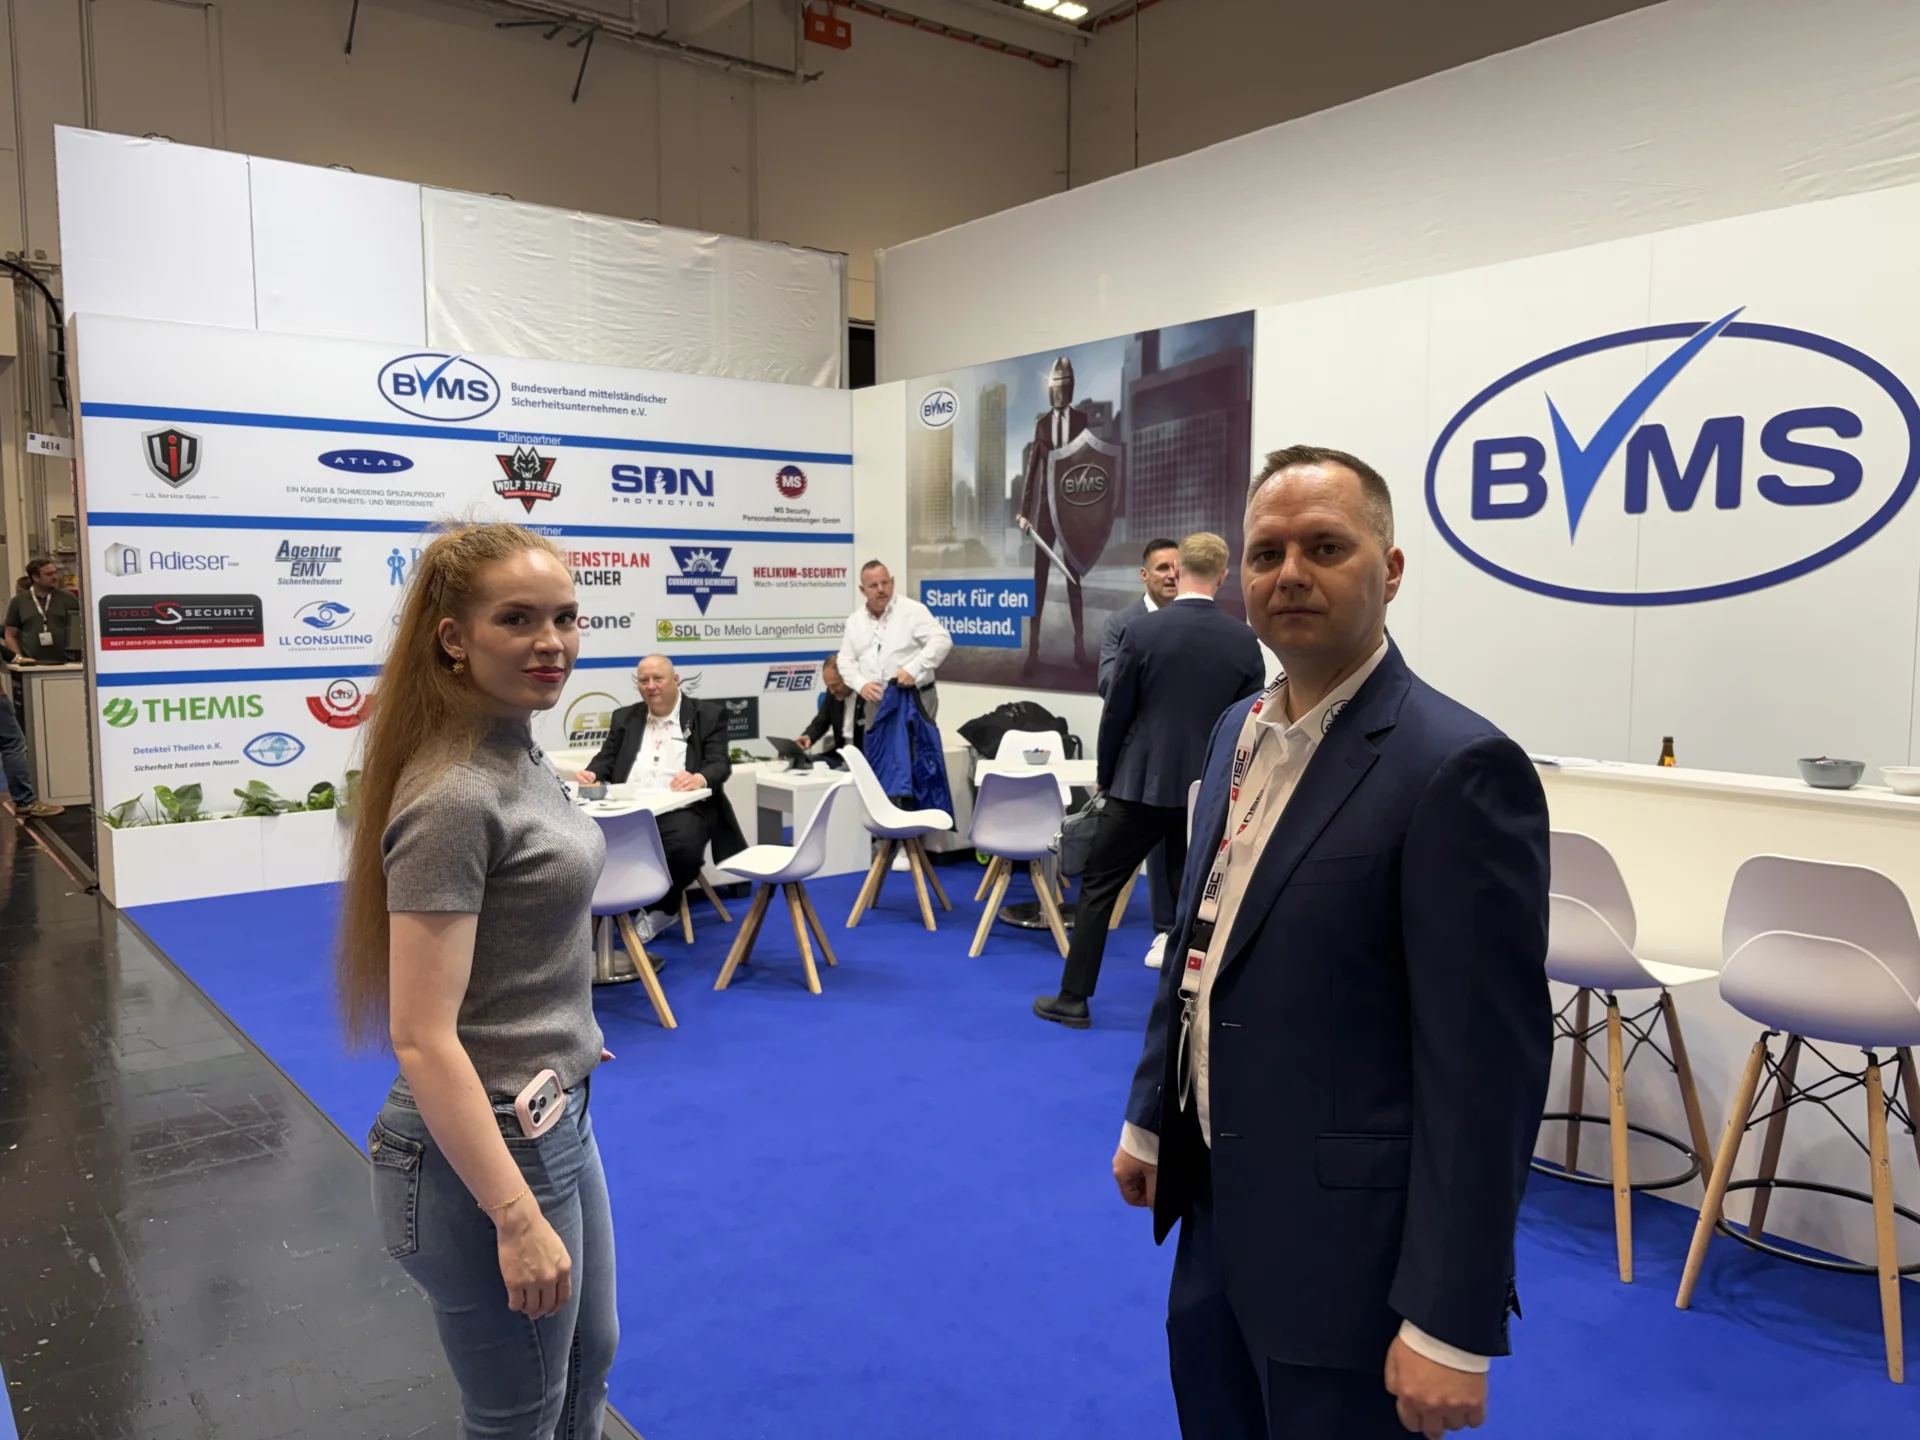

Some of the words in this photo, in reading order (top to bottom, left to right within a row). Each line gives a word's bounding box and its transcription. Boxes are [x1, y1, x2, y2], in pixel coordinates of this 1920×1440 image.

[392, 357, 489, 403] BVMS
[511, 382, 586, 397] Bundesverband
[588, 389, 667, 404] mittelständischer
[511, 397, 628, 415] Sicherheitsunternehmen
[630, 408, 647, 416] e.V.
[924, 392, 953, 417] BVMS
[498, 432, 561, 446] Platinpartner
[1471, 320, 1863, 546] BVMS
[40, 441, 60, 450] 8E14
[334, 457, 402, 467] ATLAS
[782, 475, 802, 488] MS
[1065, 464, 1105, 494] BVMS
[286, 485, 299, 493] EIN
[301, 485, 328, 495] KAISER
[330, 487, 335, 495] &
[337, 487, 384, 497] SCHMEDDING
[386, 489, 445, 499] SPEZIALPRODUKT
[495, 480, 521, 493] WOLF
[525, 480, 560, 494] STREET
[300, 495, 316, 504] FÜR
[612, 497, 715, 508] PROTECTION
[786, 508, 811, 516] Security
[275, 540, 342, 561] Agentur
[150, 551, 229, 570] Adieser
[290, 562, 326, 577] EMV
[753, 567, 847, 578] HELIKUM-SECURITY
[278, 578, 342, 586] Sicherheitsdienst
[926, 588, 966, 607] Stark
[970, 589, 993, 607] für
[998, 589, 1028, 607] den
[185, 609, 254, 617] SECURITY
[675, 625, 700, 637] SDL
[705, 625, 720, 636] De
[724, 624, 751, 636] Melo
[755, 623, 814, 638] Langenfeld
[279, 636, 291, 645] LL
[294, 634, 373, 645] CONSULTING
[142, 695, 264, 722] THEMIS
[133, 745, 171, 755] Detektei
[173, 743, 205, 752] Theilen
[206, 742, 223, 750] e.K.
[133, 763, 173, 772] Sicherheit
[212, 759, 240, 767] Namen
